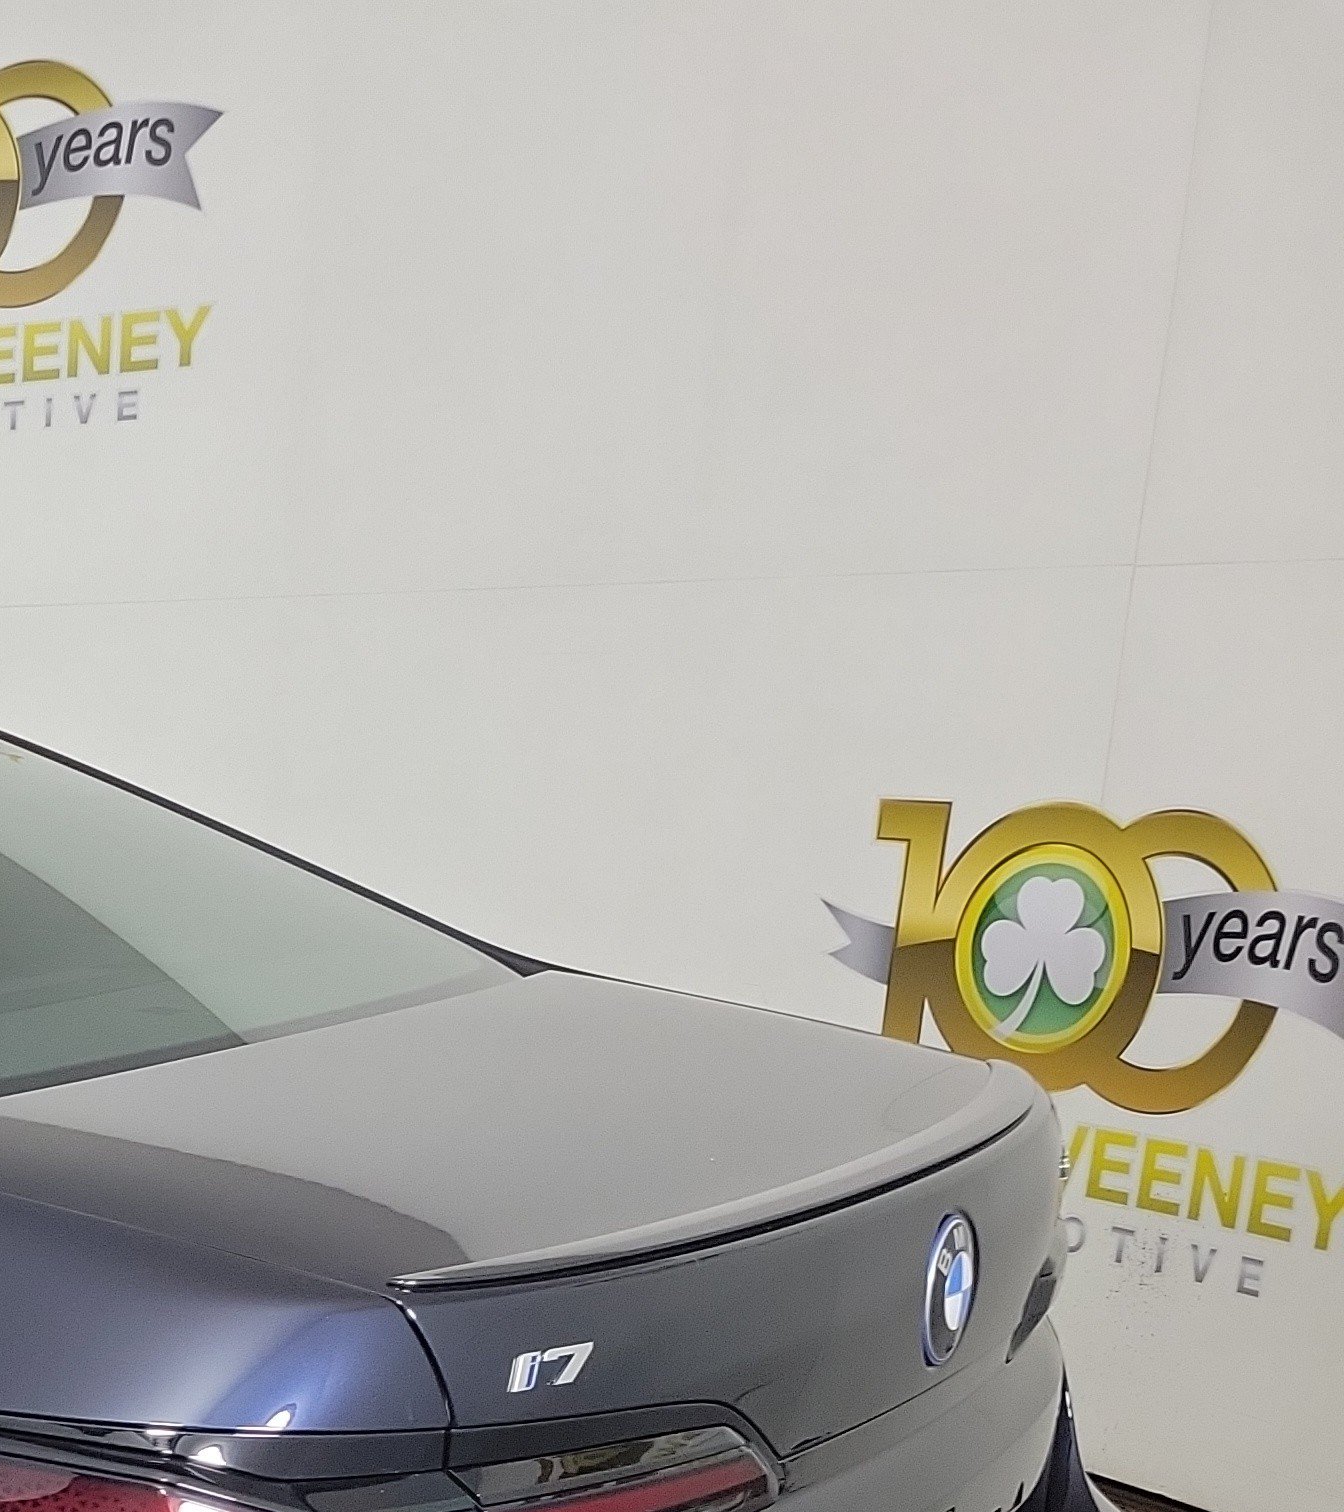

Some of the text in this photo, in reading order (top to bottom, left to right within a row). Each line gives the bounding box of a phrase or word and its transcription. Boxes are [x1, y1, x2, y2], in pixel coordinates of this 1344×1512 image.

[31, 115, 175, 196] years
[1172, 908, 1344, 984] years
[1065, 1124, 1344, 1251] EENEY
[1062, 1216, 1264, 1298] OTIVE
[507, 1341, 595, 1393] i7
